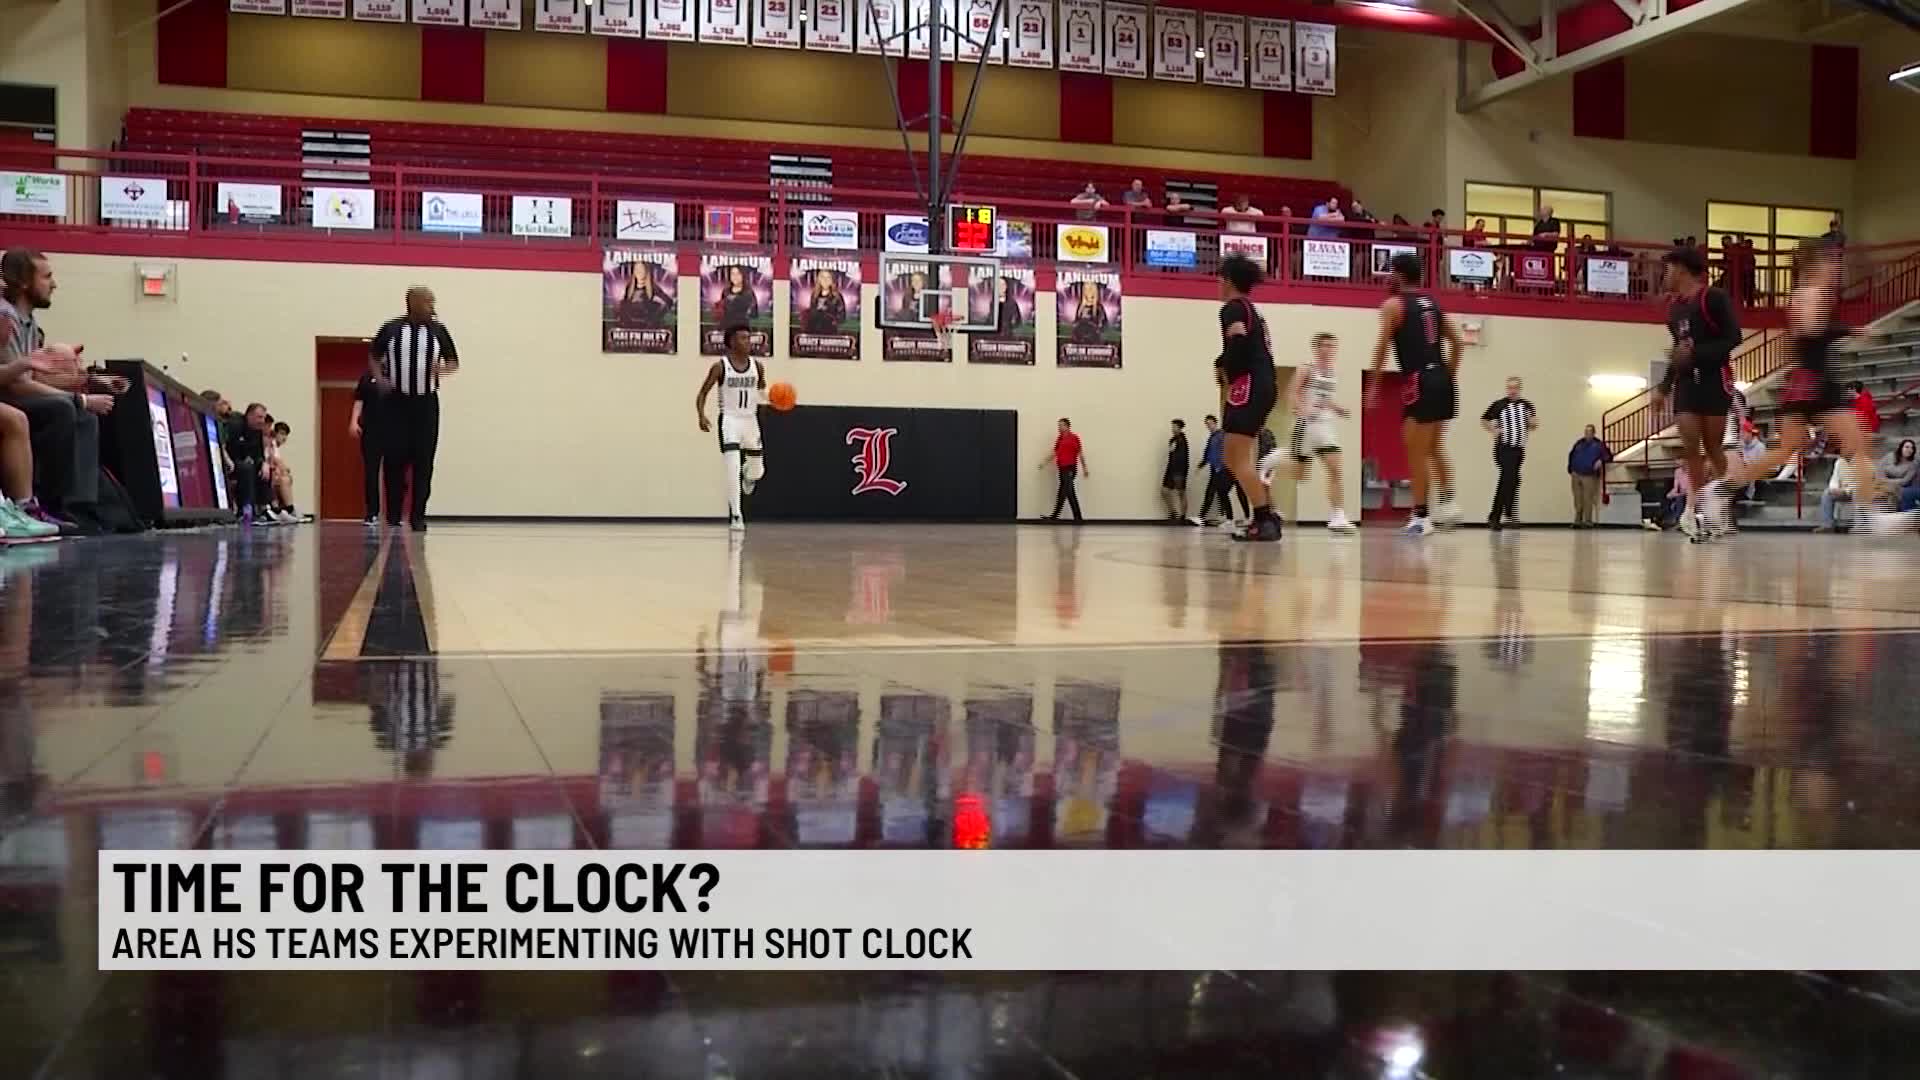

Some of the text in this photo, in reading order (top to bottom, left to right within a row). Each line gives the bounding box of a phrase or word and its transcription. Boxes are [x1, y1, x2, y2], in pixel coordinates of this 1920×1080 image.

[768, 0, 786, 12] 23
[820, 4, 839, 16] 21
[1022, 22, 1039, 33] 23
[1118, 32, 1134, 44] 24
[1263, 46, 1279, 58] 11
[808, 223, 854, 232] LANDRUM
[738, 389, 749, 409] 11
[846, 427, 908, 497] L
